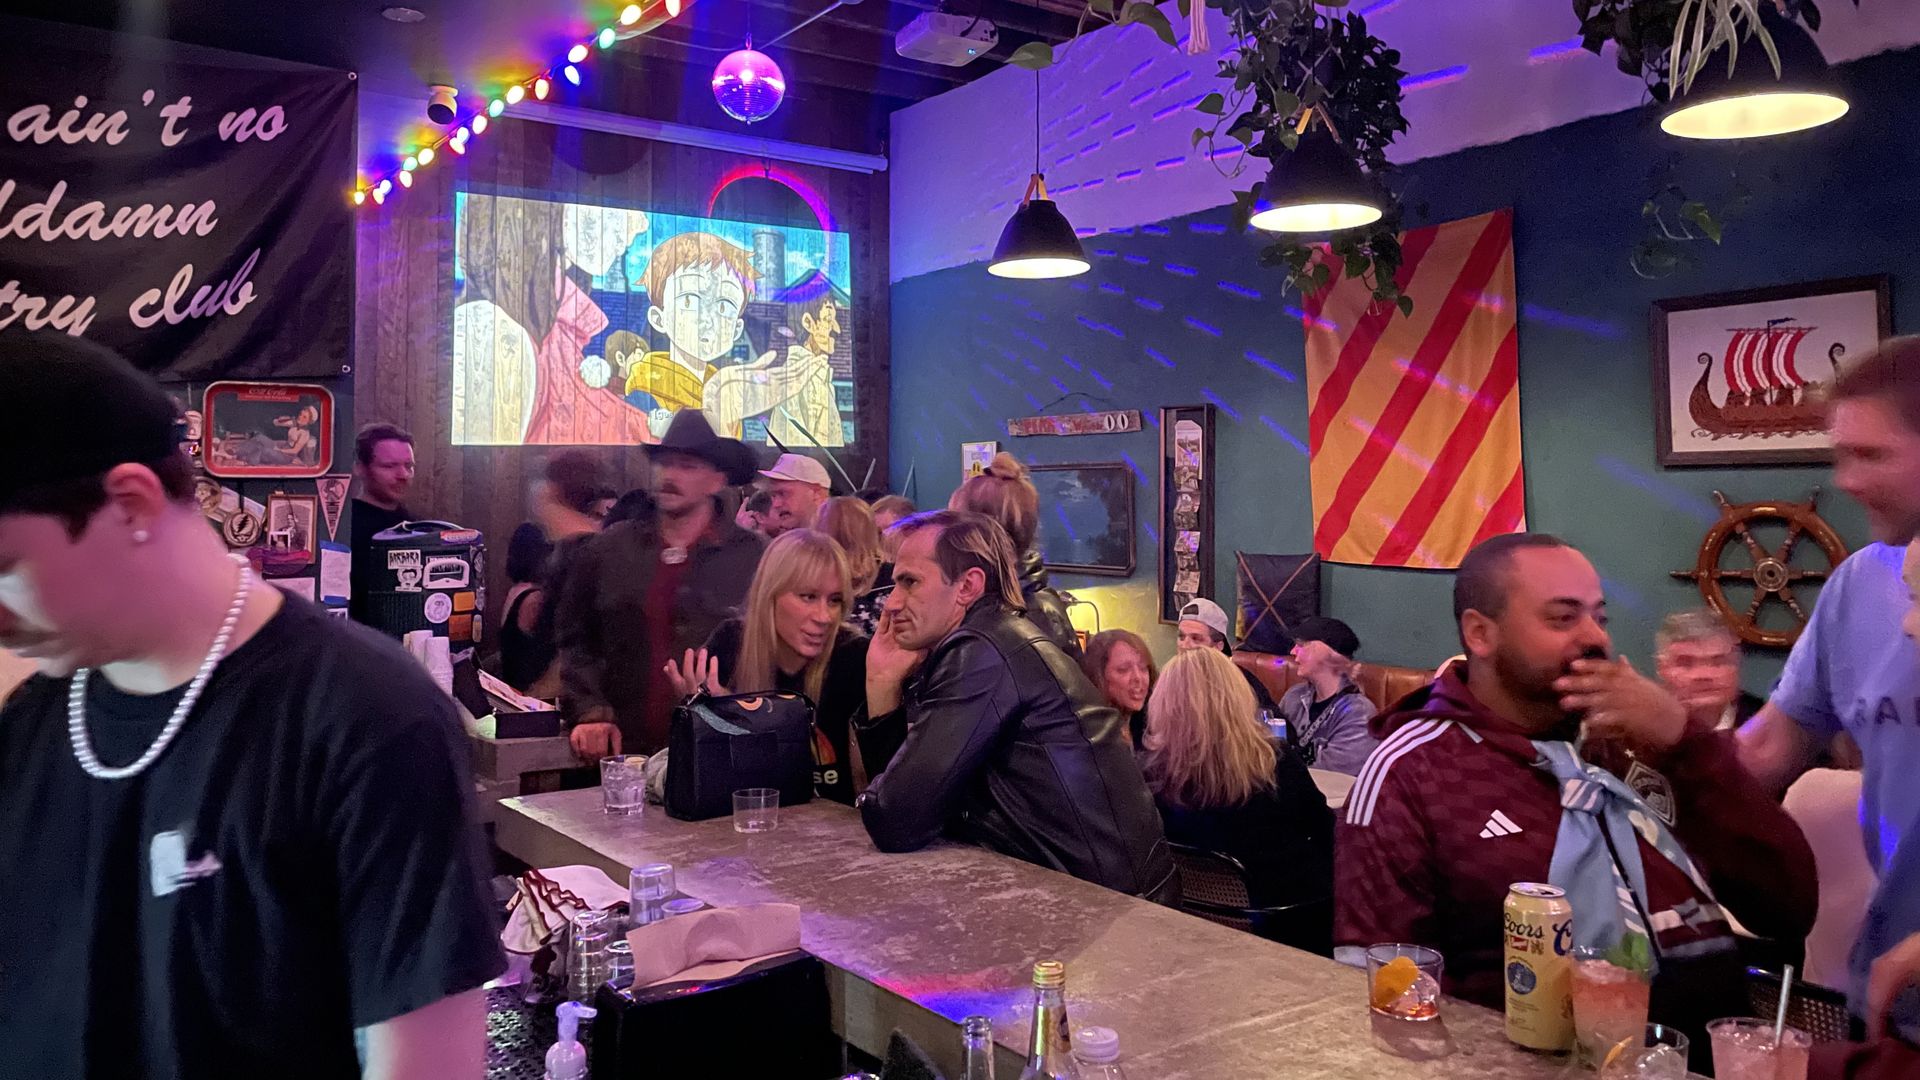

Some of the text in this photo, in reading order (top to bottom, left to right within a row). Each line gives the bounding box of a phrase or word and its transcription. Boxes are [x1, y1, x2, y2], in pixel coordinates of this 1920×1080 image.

[7, 89, 289, 147] ain't no
[129, 247, 261, 328] club
